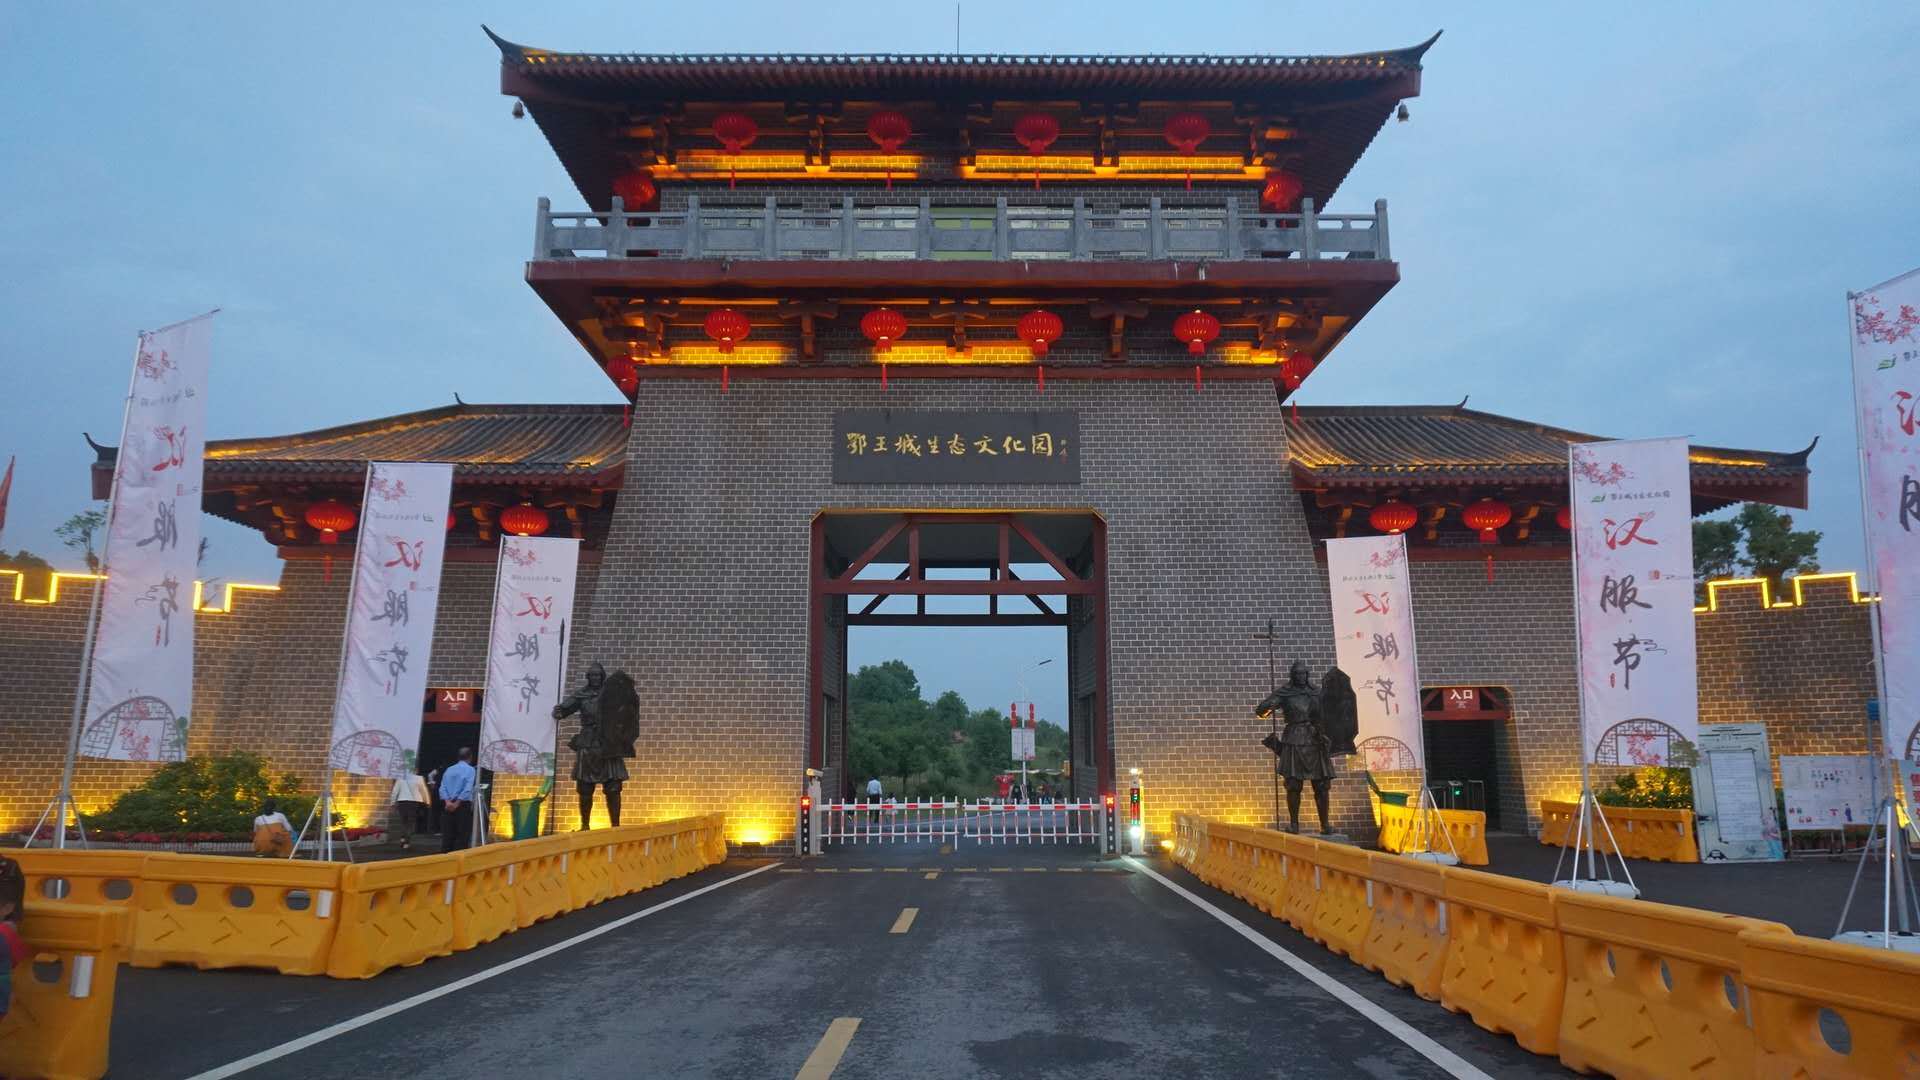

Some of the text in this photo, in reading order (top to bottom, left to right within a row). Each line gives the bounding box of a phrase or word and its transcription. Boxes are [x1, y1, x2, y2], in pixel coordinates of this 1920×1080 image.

[846, 432, 1053, 457] 鄂王城生态文化园
[1600, 517, 1660, 690] 汉服节
[442, 690, 467, 701] 入口
[1450, 689, 1473, 700] 入口
